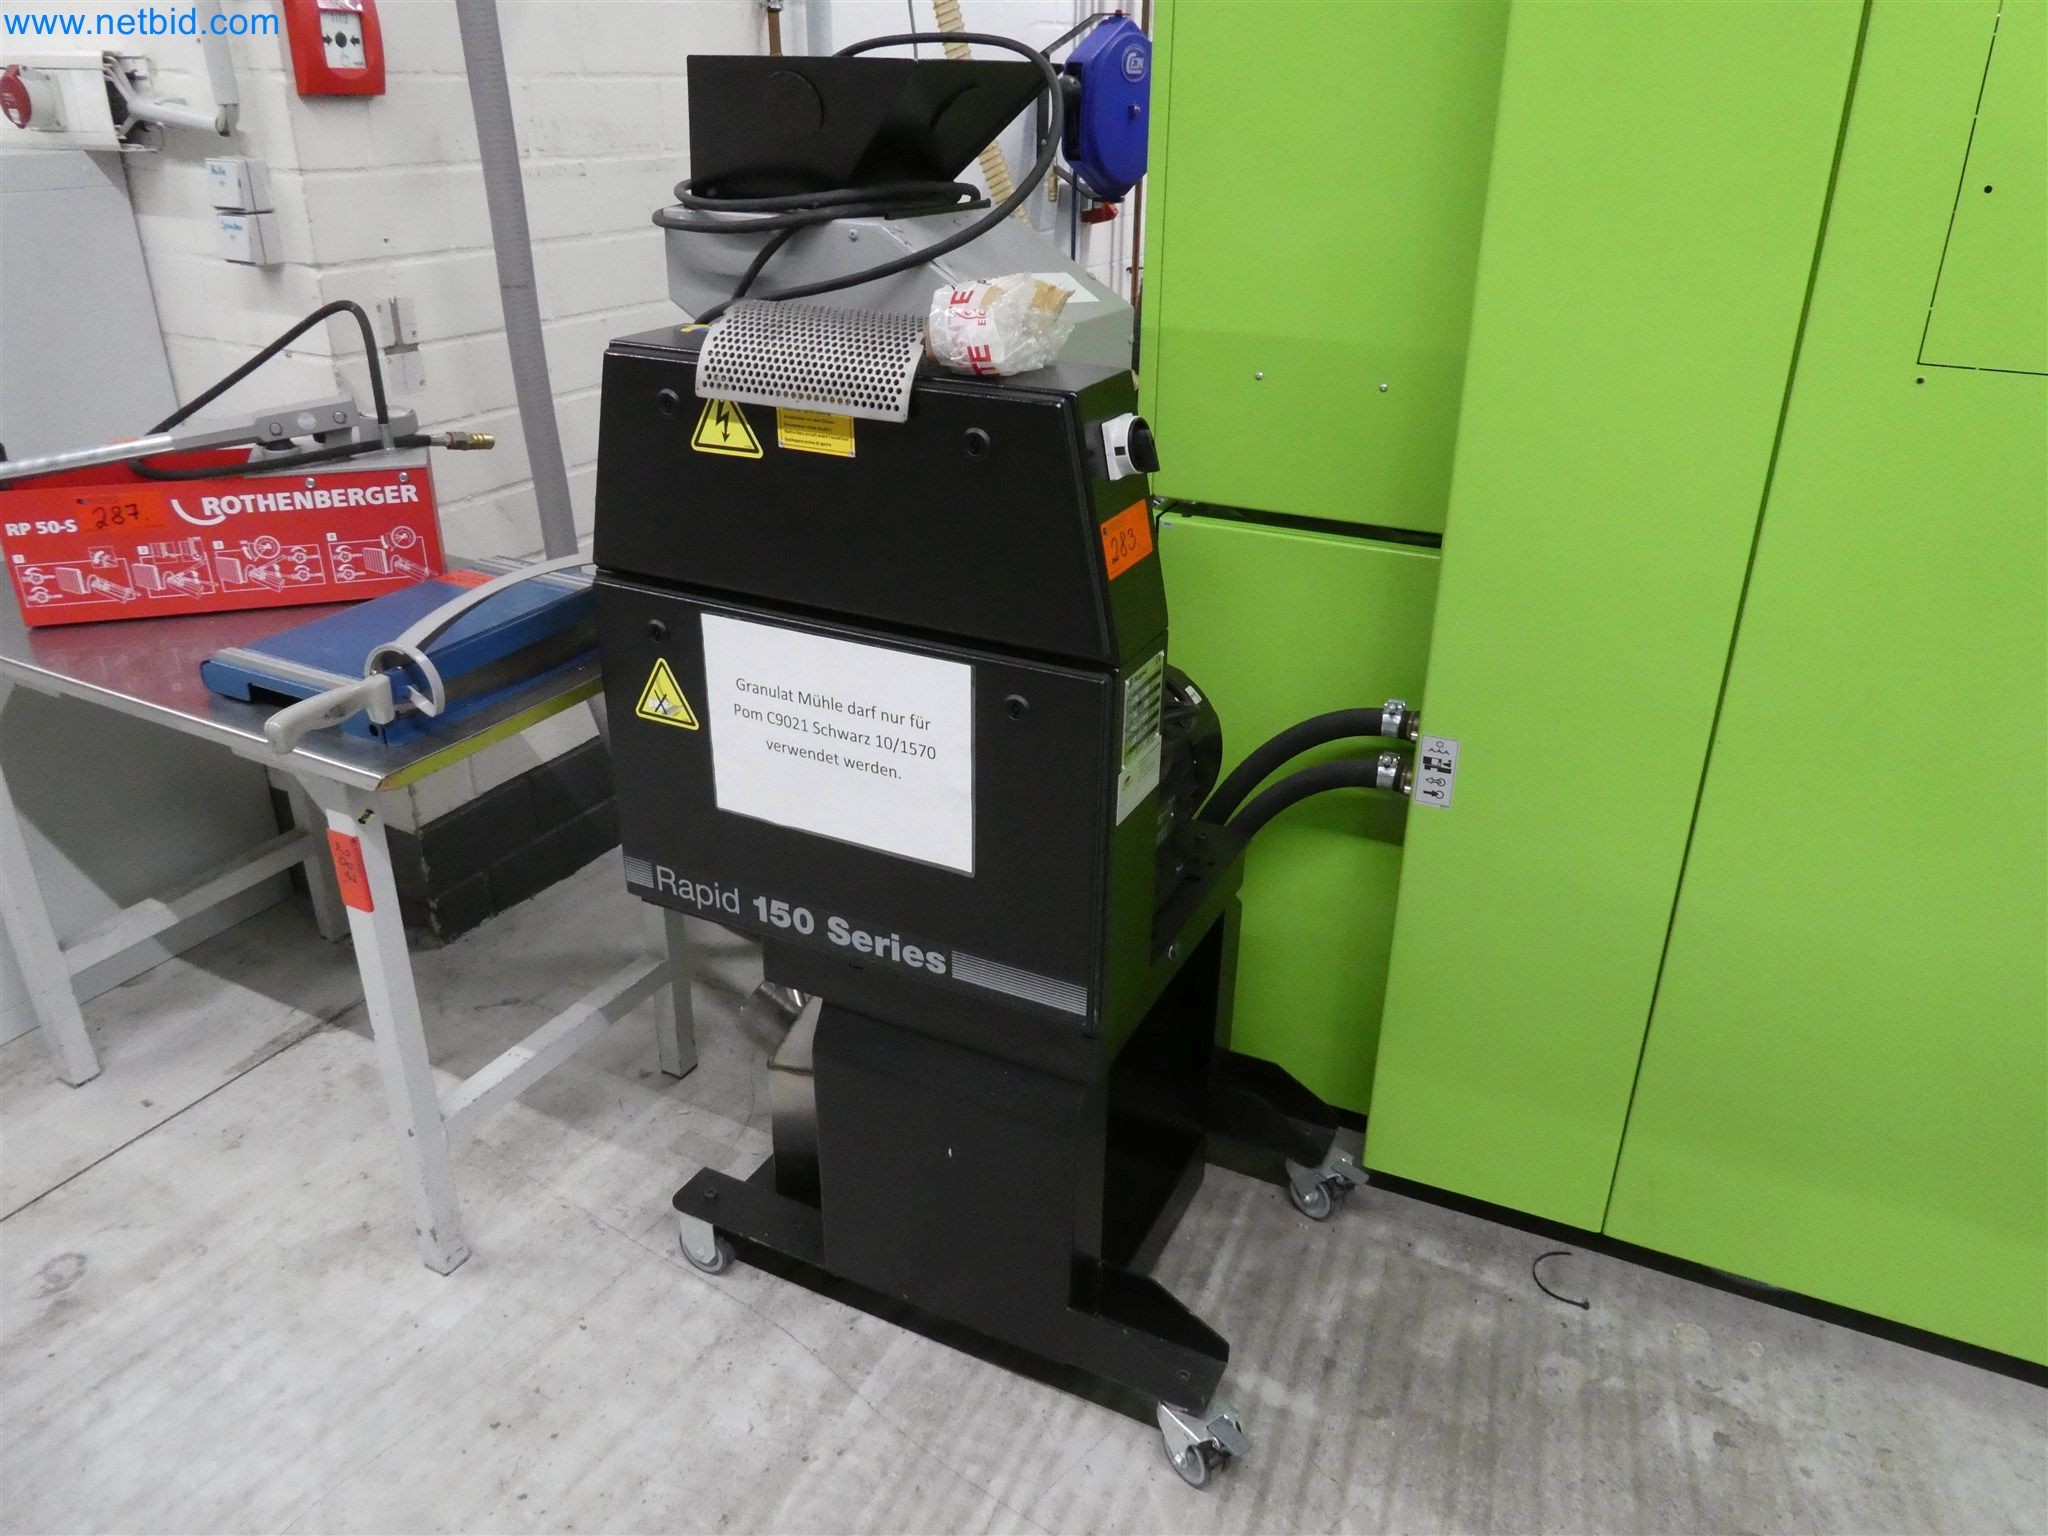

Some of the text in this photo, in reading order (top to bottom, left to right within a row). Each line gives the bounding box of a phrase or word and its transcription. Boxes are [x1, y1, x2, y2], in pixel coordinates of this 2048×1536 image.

[91, 503, 140, 530] 287
[201, 485, 419, 516] ROTHENBERGER
[5, 519, 79, 536] RP 50-S
[1110, 527, 1137, 565] 283
[735, 677, 932, 732] Granulat Mühle darf nur für
[733, 703, 937, 760] Pom C9021 Schwarz 10/1570
[765, 740, 903, 780] verwendet werden.
[656, 865, 947, 975] Rapid 150 Series
